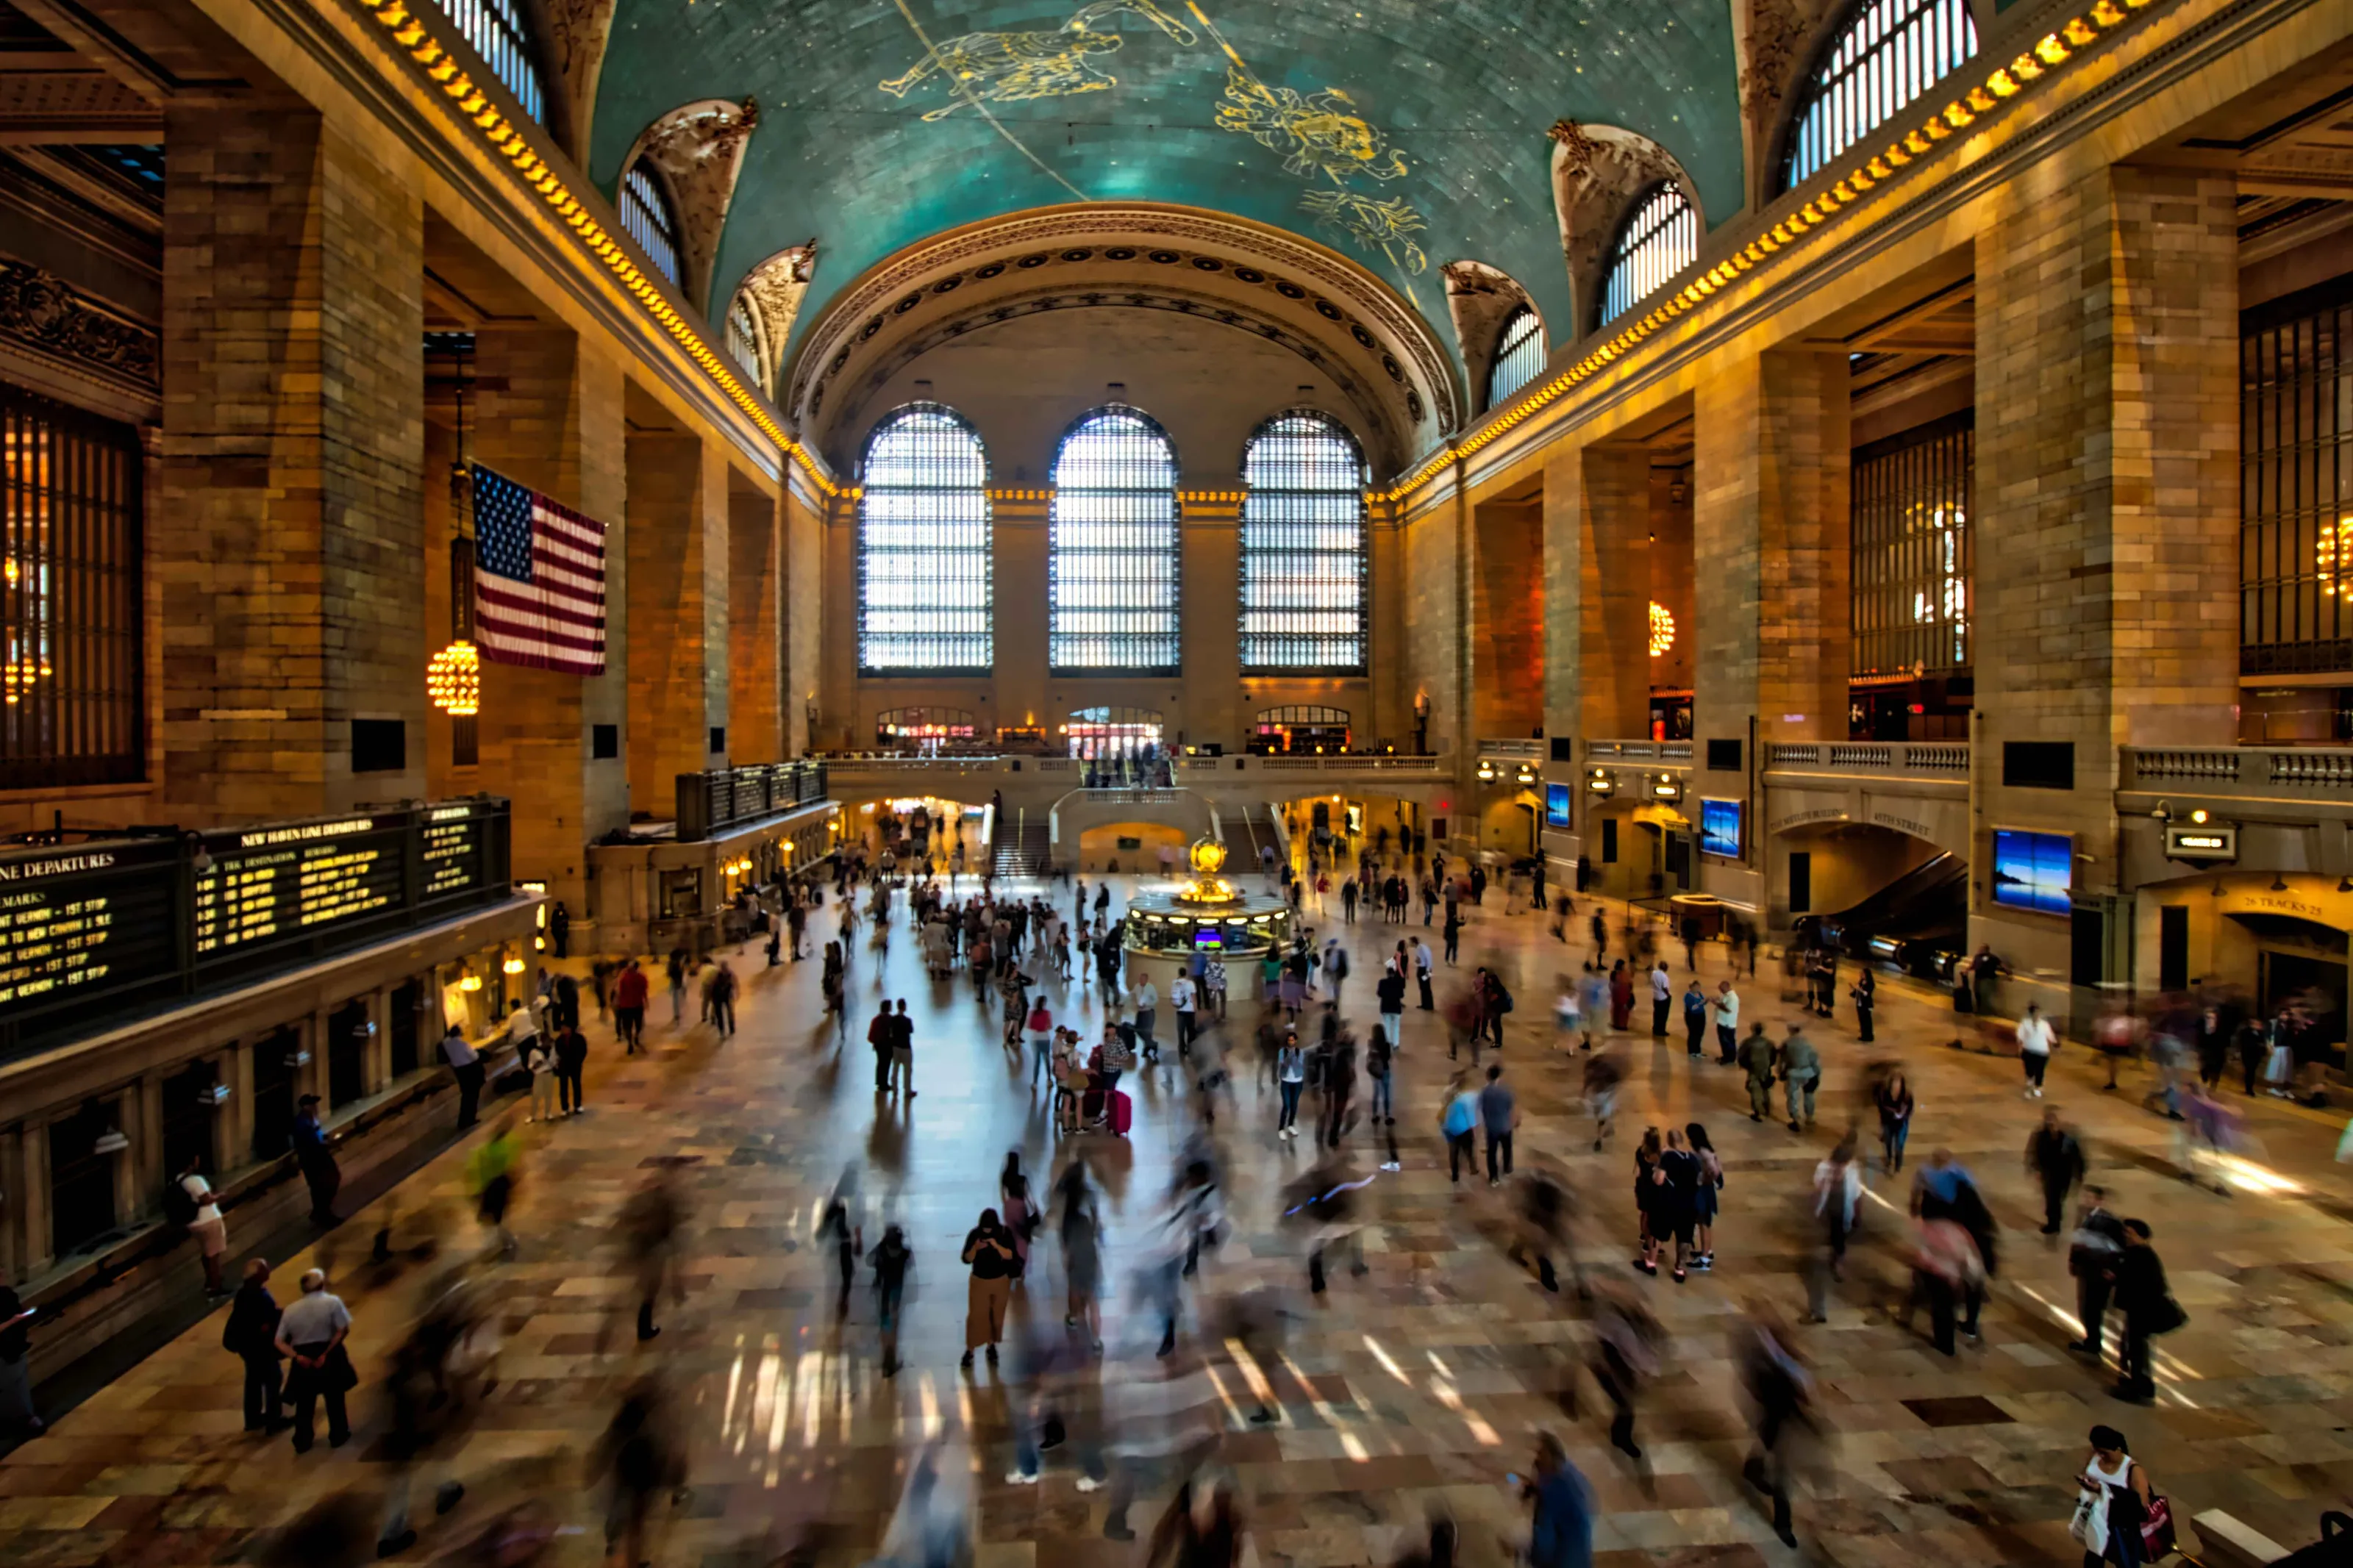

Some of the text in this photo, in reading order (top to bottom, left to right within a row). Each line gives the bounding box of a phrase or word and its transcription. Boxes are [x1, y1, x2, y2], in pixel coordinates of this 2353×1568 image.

[1896, 817, 1930, 837] STREET
[241, 832, 265, 848] NEW
[24, 853, 115, 878] DEPARTURES
[85, 897, 108, 912] STOP
[2260, 898, 2307, 913] TRACKS
[85, 931, 108, 946] STOP
[65, 952, 89, 967] STOP
[86, 964, 109, 981] STOP
